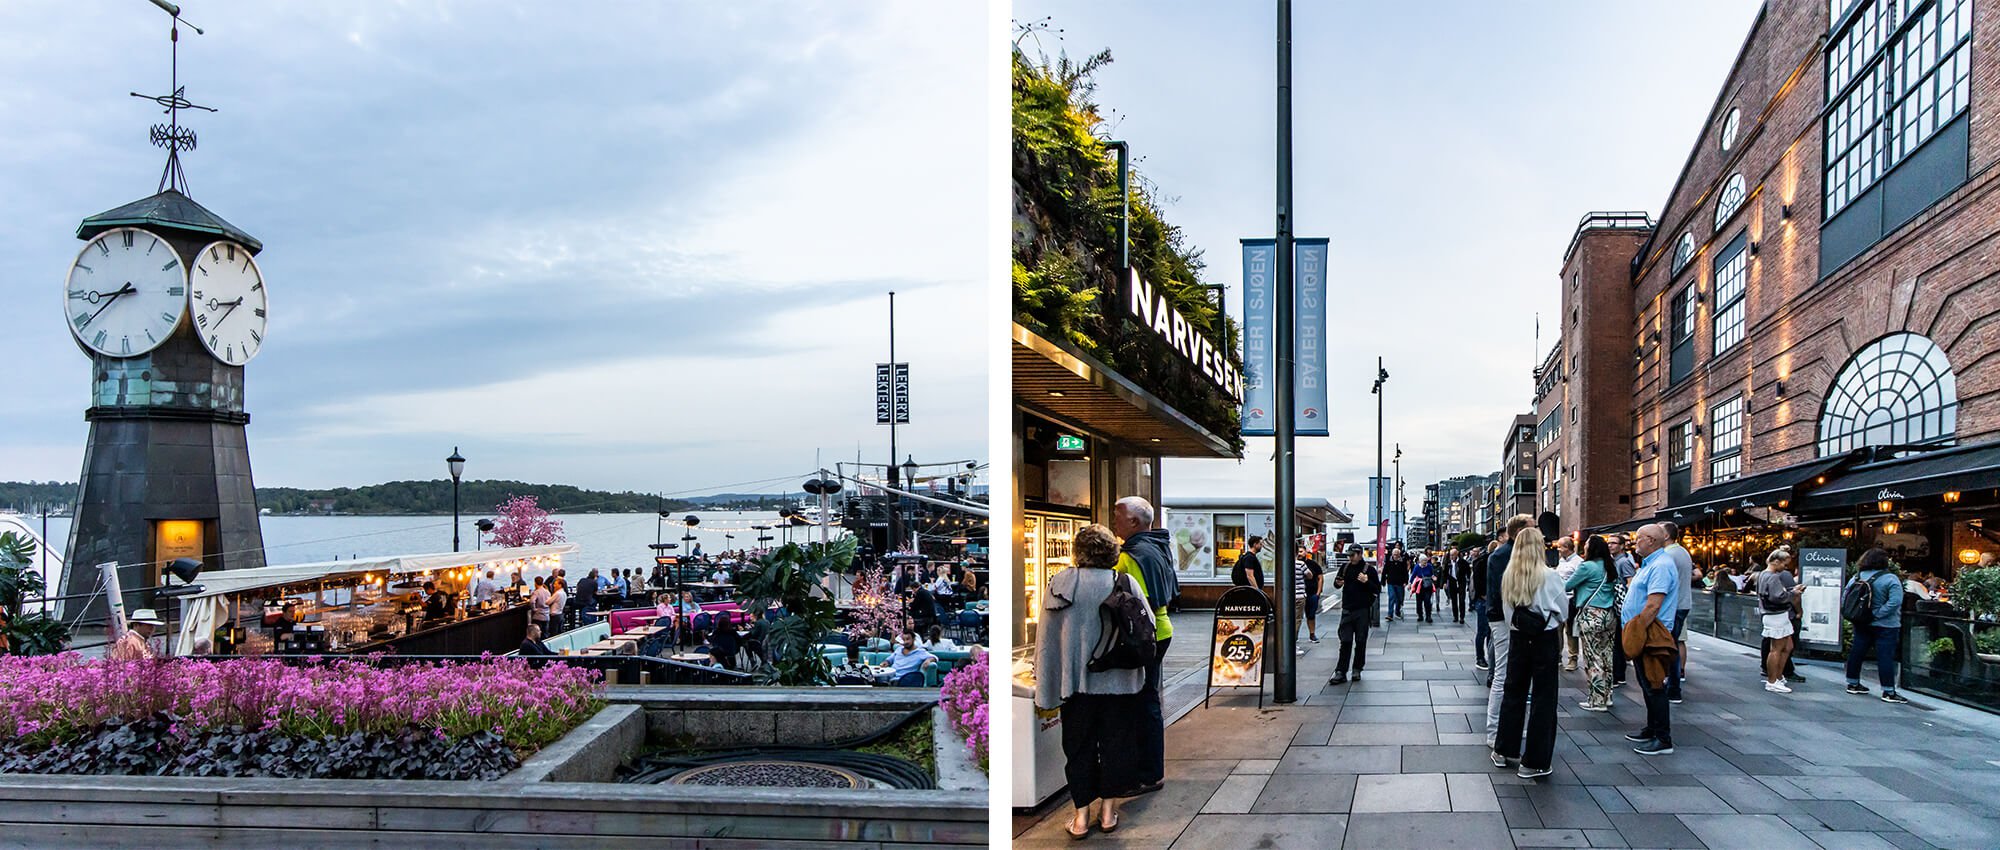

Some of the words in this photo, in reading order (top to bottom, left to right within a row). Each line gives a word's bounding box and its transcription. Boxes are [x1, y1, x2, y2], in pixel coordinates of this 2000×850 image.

[1250, 250, 1265, 310] SJØEN
[1131, 265, 1244, 404] NARVESEN
[877, 367, 889, 419] LEKTER'N
[896, 368, 908, 420] LEKTER'N
[1878, 488, 1904, 499] Olivia
[1805, 551, 1840, 563] Olivia
